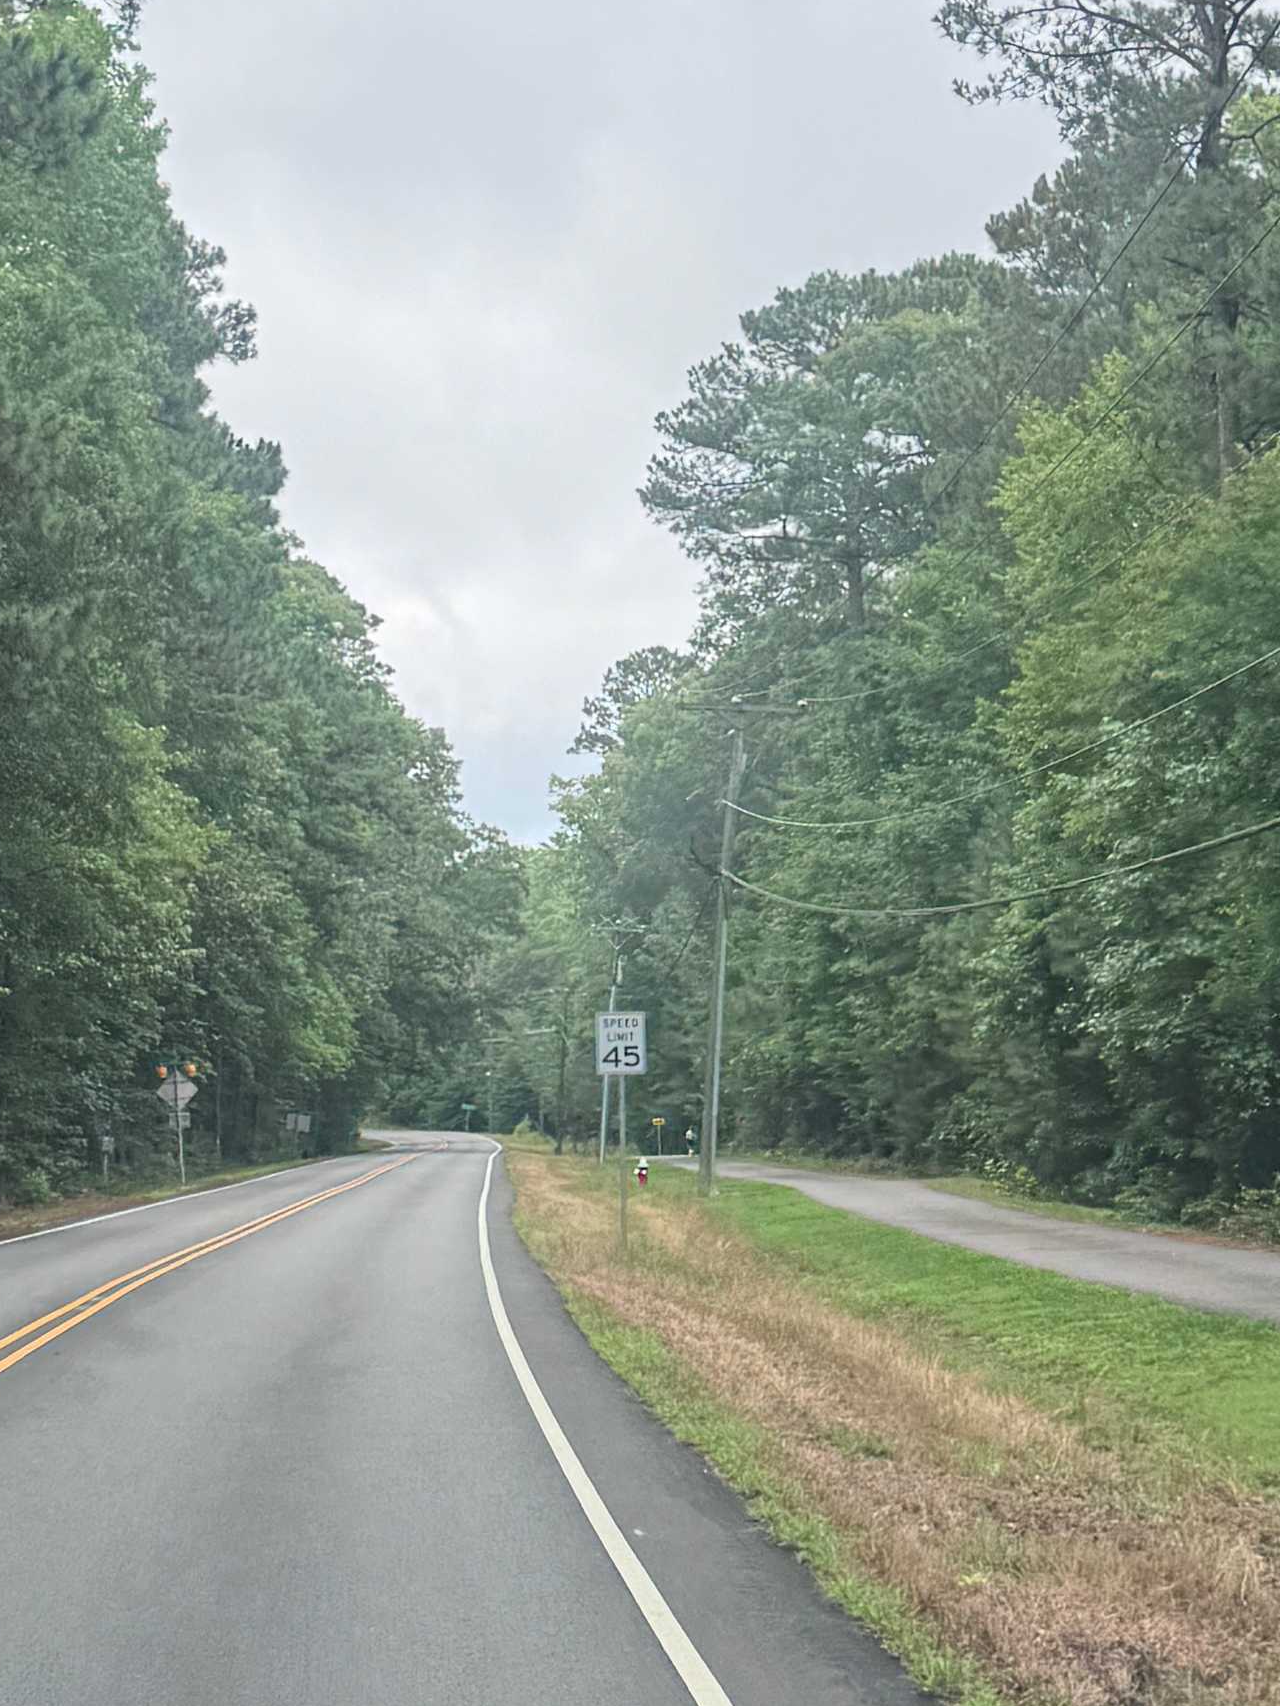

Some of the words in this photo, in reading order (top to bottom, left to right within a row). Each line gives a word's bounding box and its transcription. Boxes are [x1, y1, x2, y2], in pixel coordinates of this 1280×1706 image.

[603, 1018, 639, 1028] SPEED
[607, 1031, 634, 1042] LIMIT
[602, 1046, 640, 1068] 45
